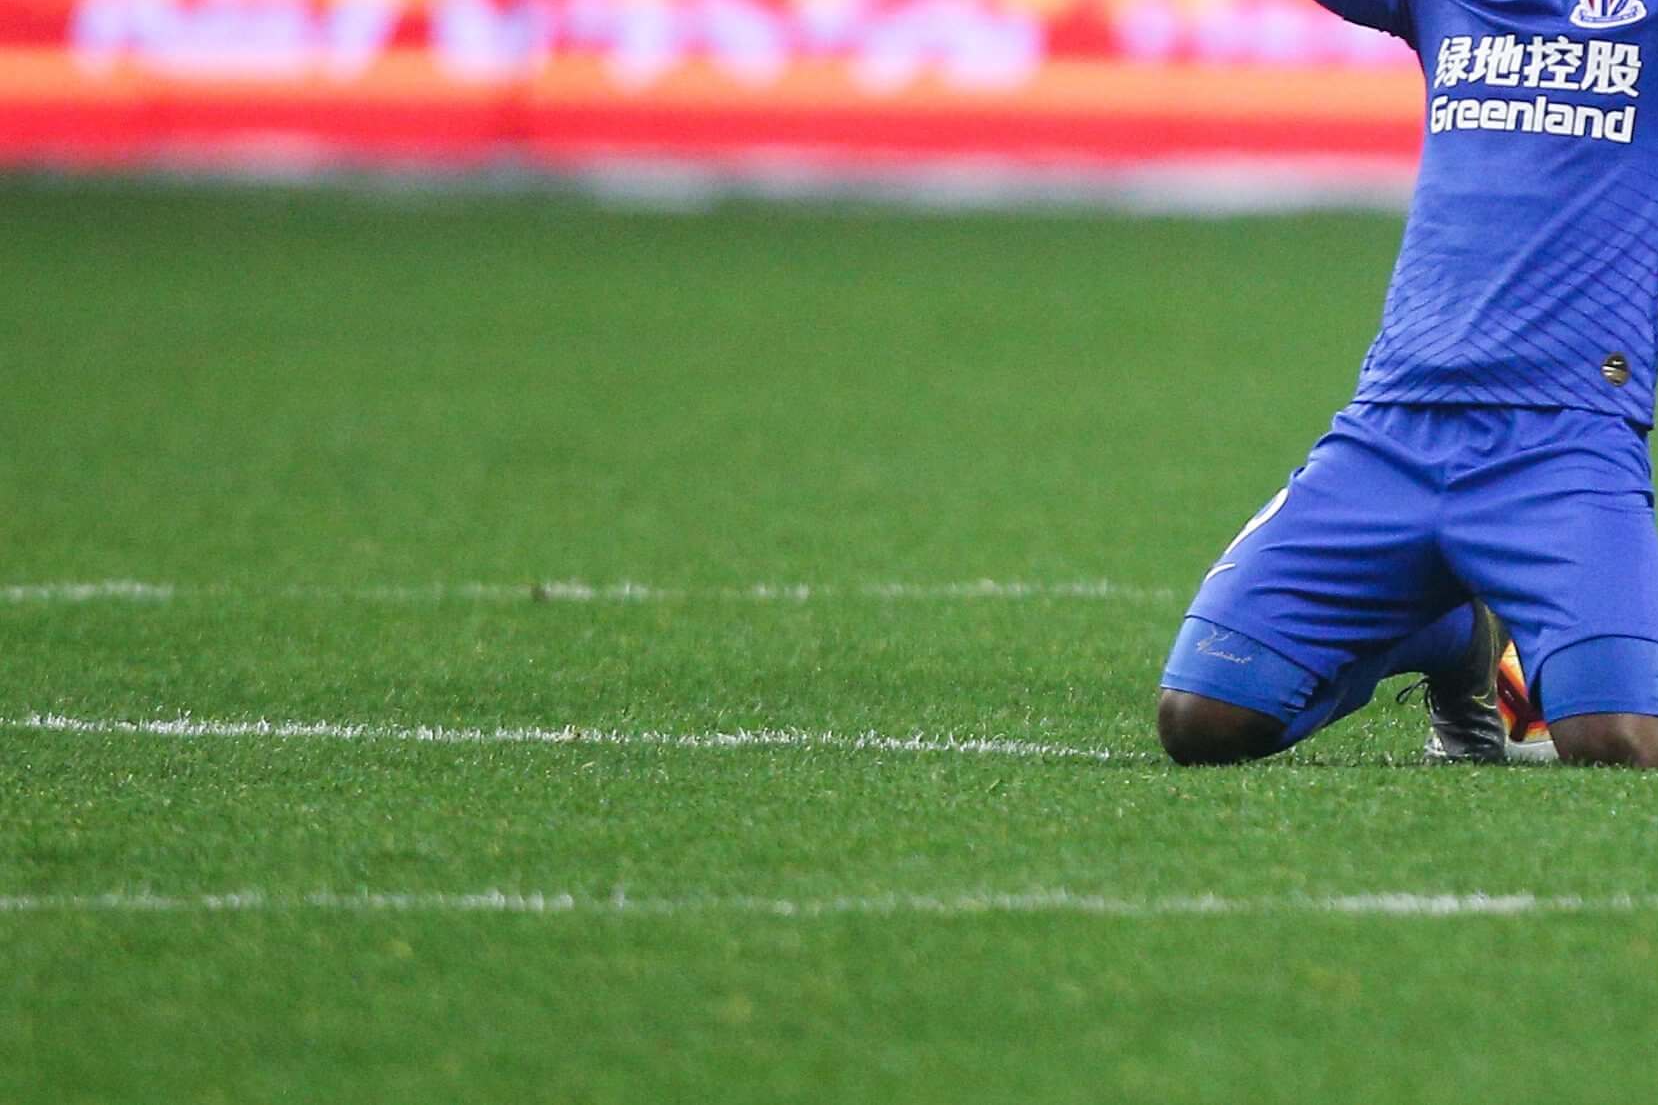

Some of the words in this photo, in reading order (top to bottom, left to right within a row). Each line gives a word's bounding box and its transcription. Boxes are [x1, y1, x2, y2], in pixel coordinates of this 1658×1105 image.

[1432, 34, 1642, 98] 绿地控股
[1429, 94, 1637, 144] Greenland
